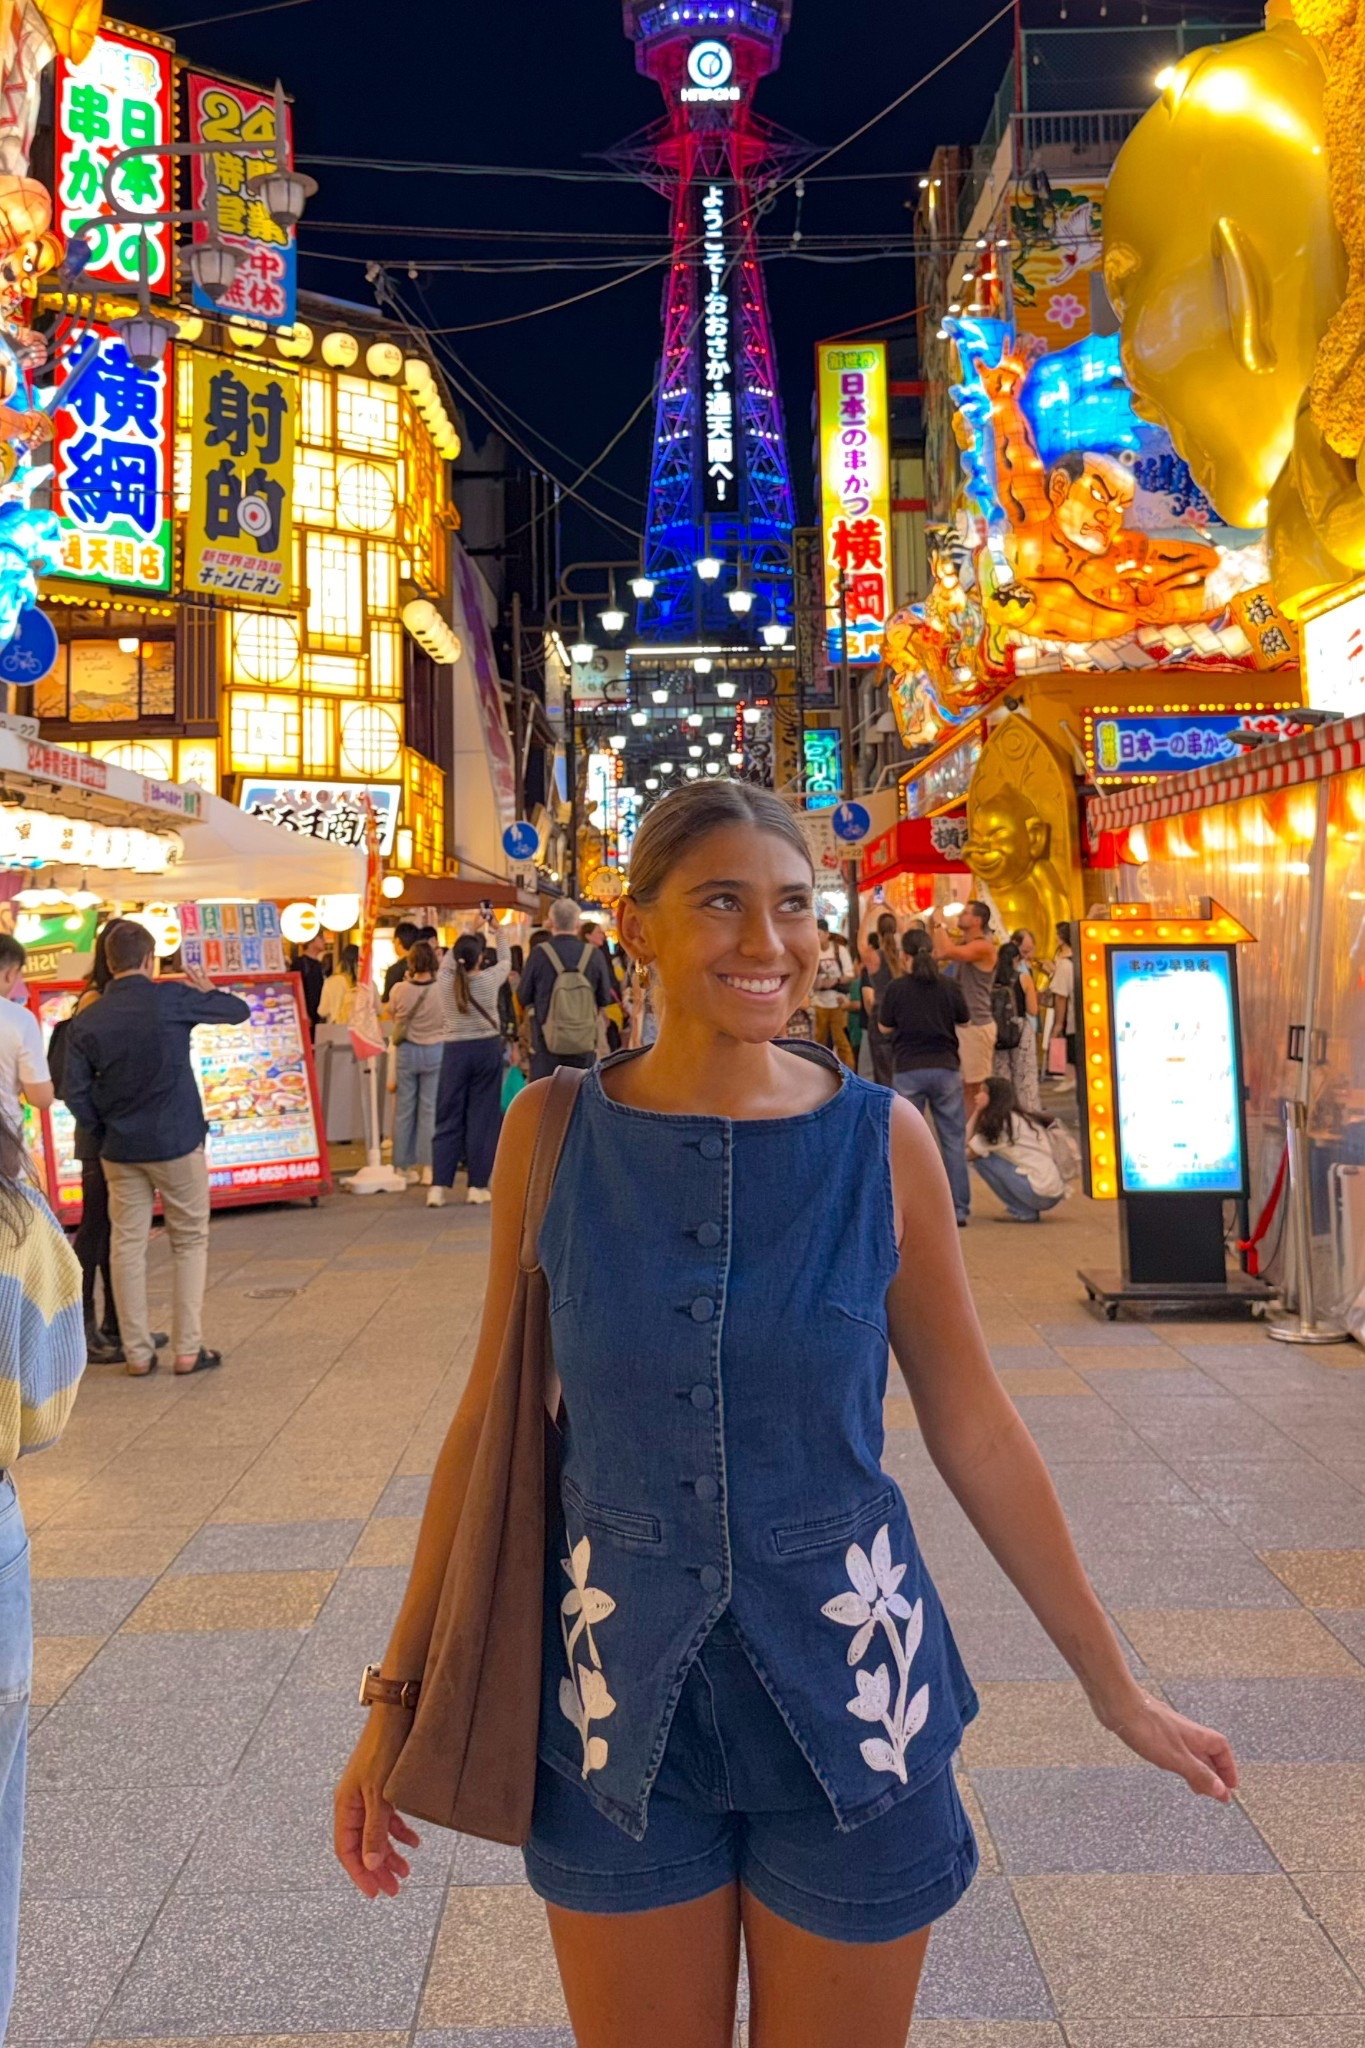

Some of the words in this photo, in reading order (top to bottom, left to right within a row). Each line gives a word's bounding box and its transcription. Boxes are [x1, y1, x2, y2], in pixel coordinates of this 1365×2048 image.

[201, 90, 278, 145] 24
[681, 87, 740, 101] HITACHI
[119, 98, 159, 277] 日本の
[65, 334, 157, 534] 横綱
[840, 372, 870, 515] 日本一の串かつ
[204, 369, 289, 554] 射的
[60, 535, 160, 580] 通天閣店
[199, 566, 282, 596] チャンピオン
[1121, 729, 1237, 759] 日本一の串かつ
[934, 827, 969, 850] 横
